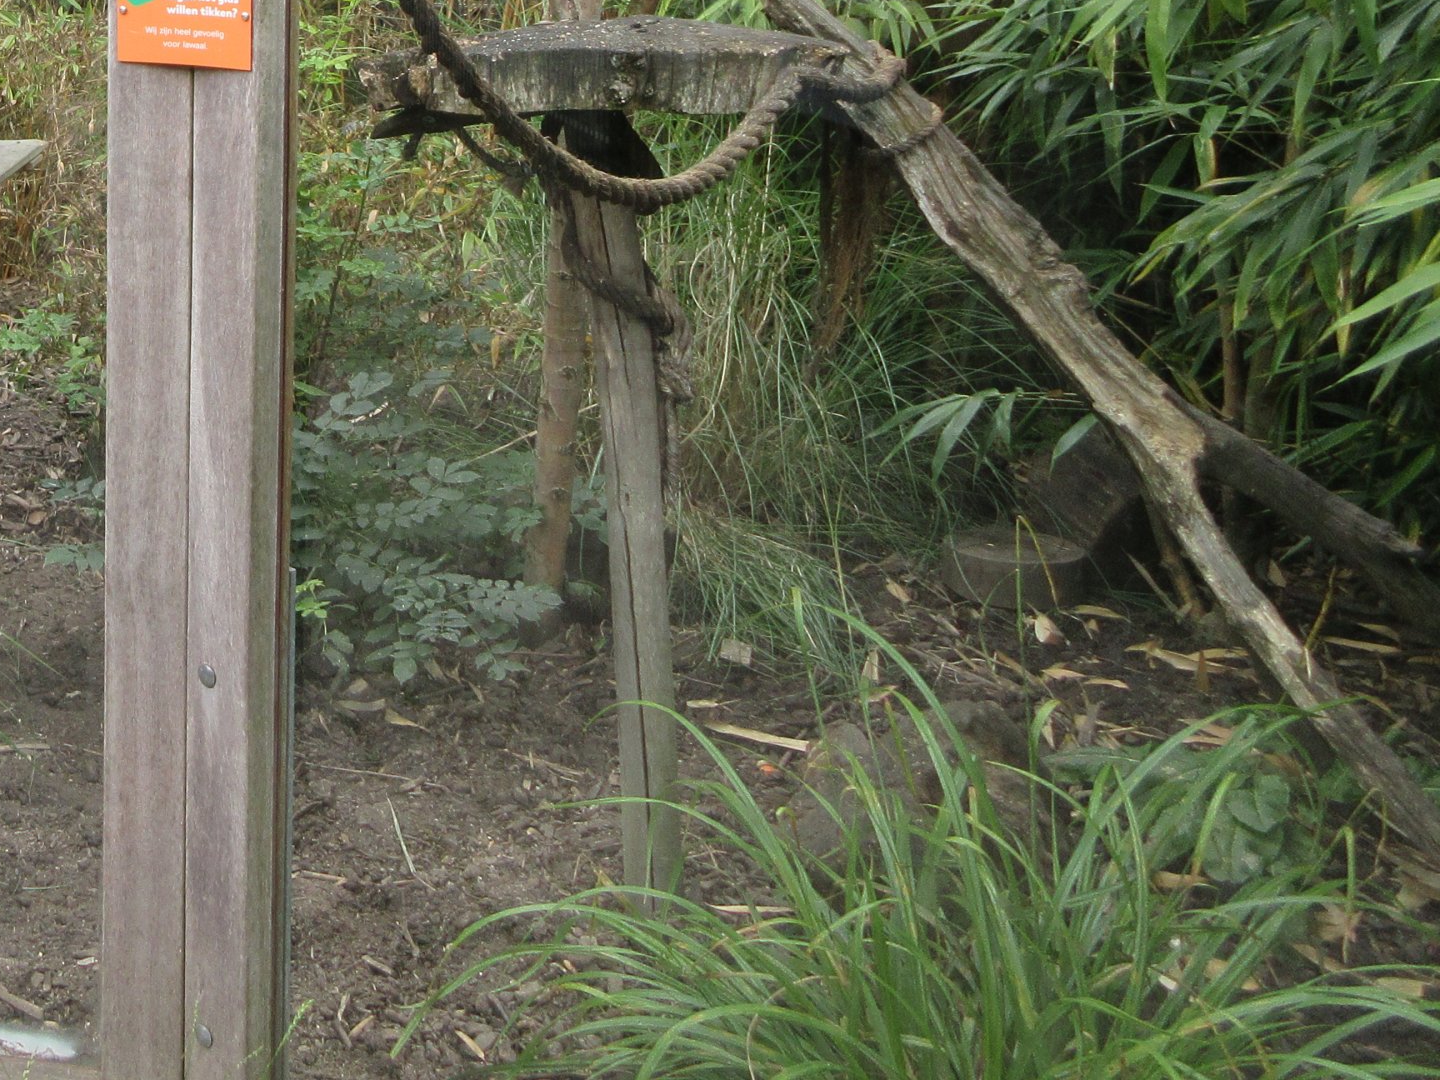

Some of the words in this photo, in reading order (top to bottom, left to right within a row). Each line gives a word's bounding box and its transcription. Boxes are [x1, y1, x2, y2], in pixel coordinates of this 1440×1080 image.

[166, 4, 198, 15] willen
[200, 6, 238, 18] tikken?
[145, 26, 157, 36] Wij
[159, 26, 172, 36] zijn
[174, 27, 191, 36] heel
[193, 28, 224, 39] gevoelig
[163, 40, 180, 49] voor
